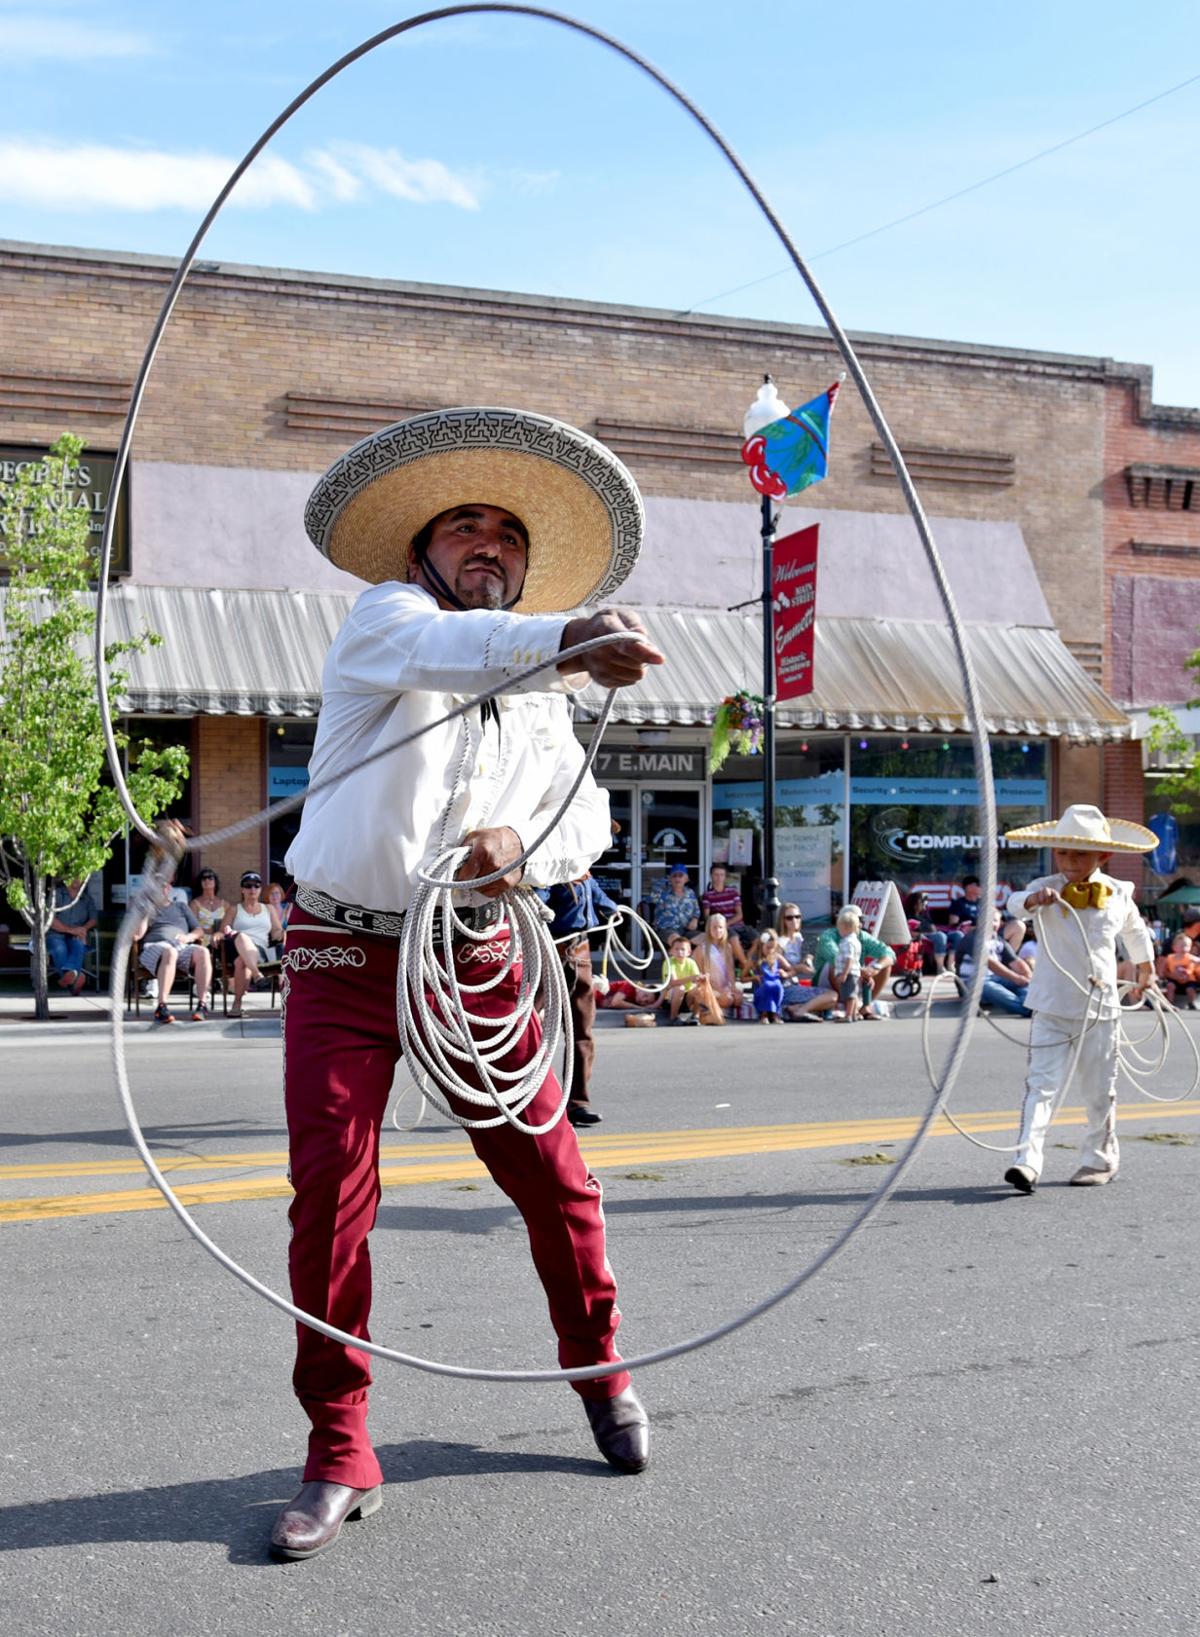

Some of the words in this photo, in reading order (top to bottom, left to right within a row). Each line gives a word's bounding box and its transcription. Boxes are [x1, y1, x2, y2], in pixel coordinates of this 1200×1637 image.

[775, 559, 817, 584] Welcome
[619, 754, 694, 772] E.MAIN
[852, 786, 888, 795] Security
